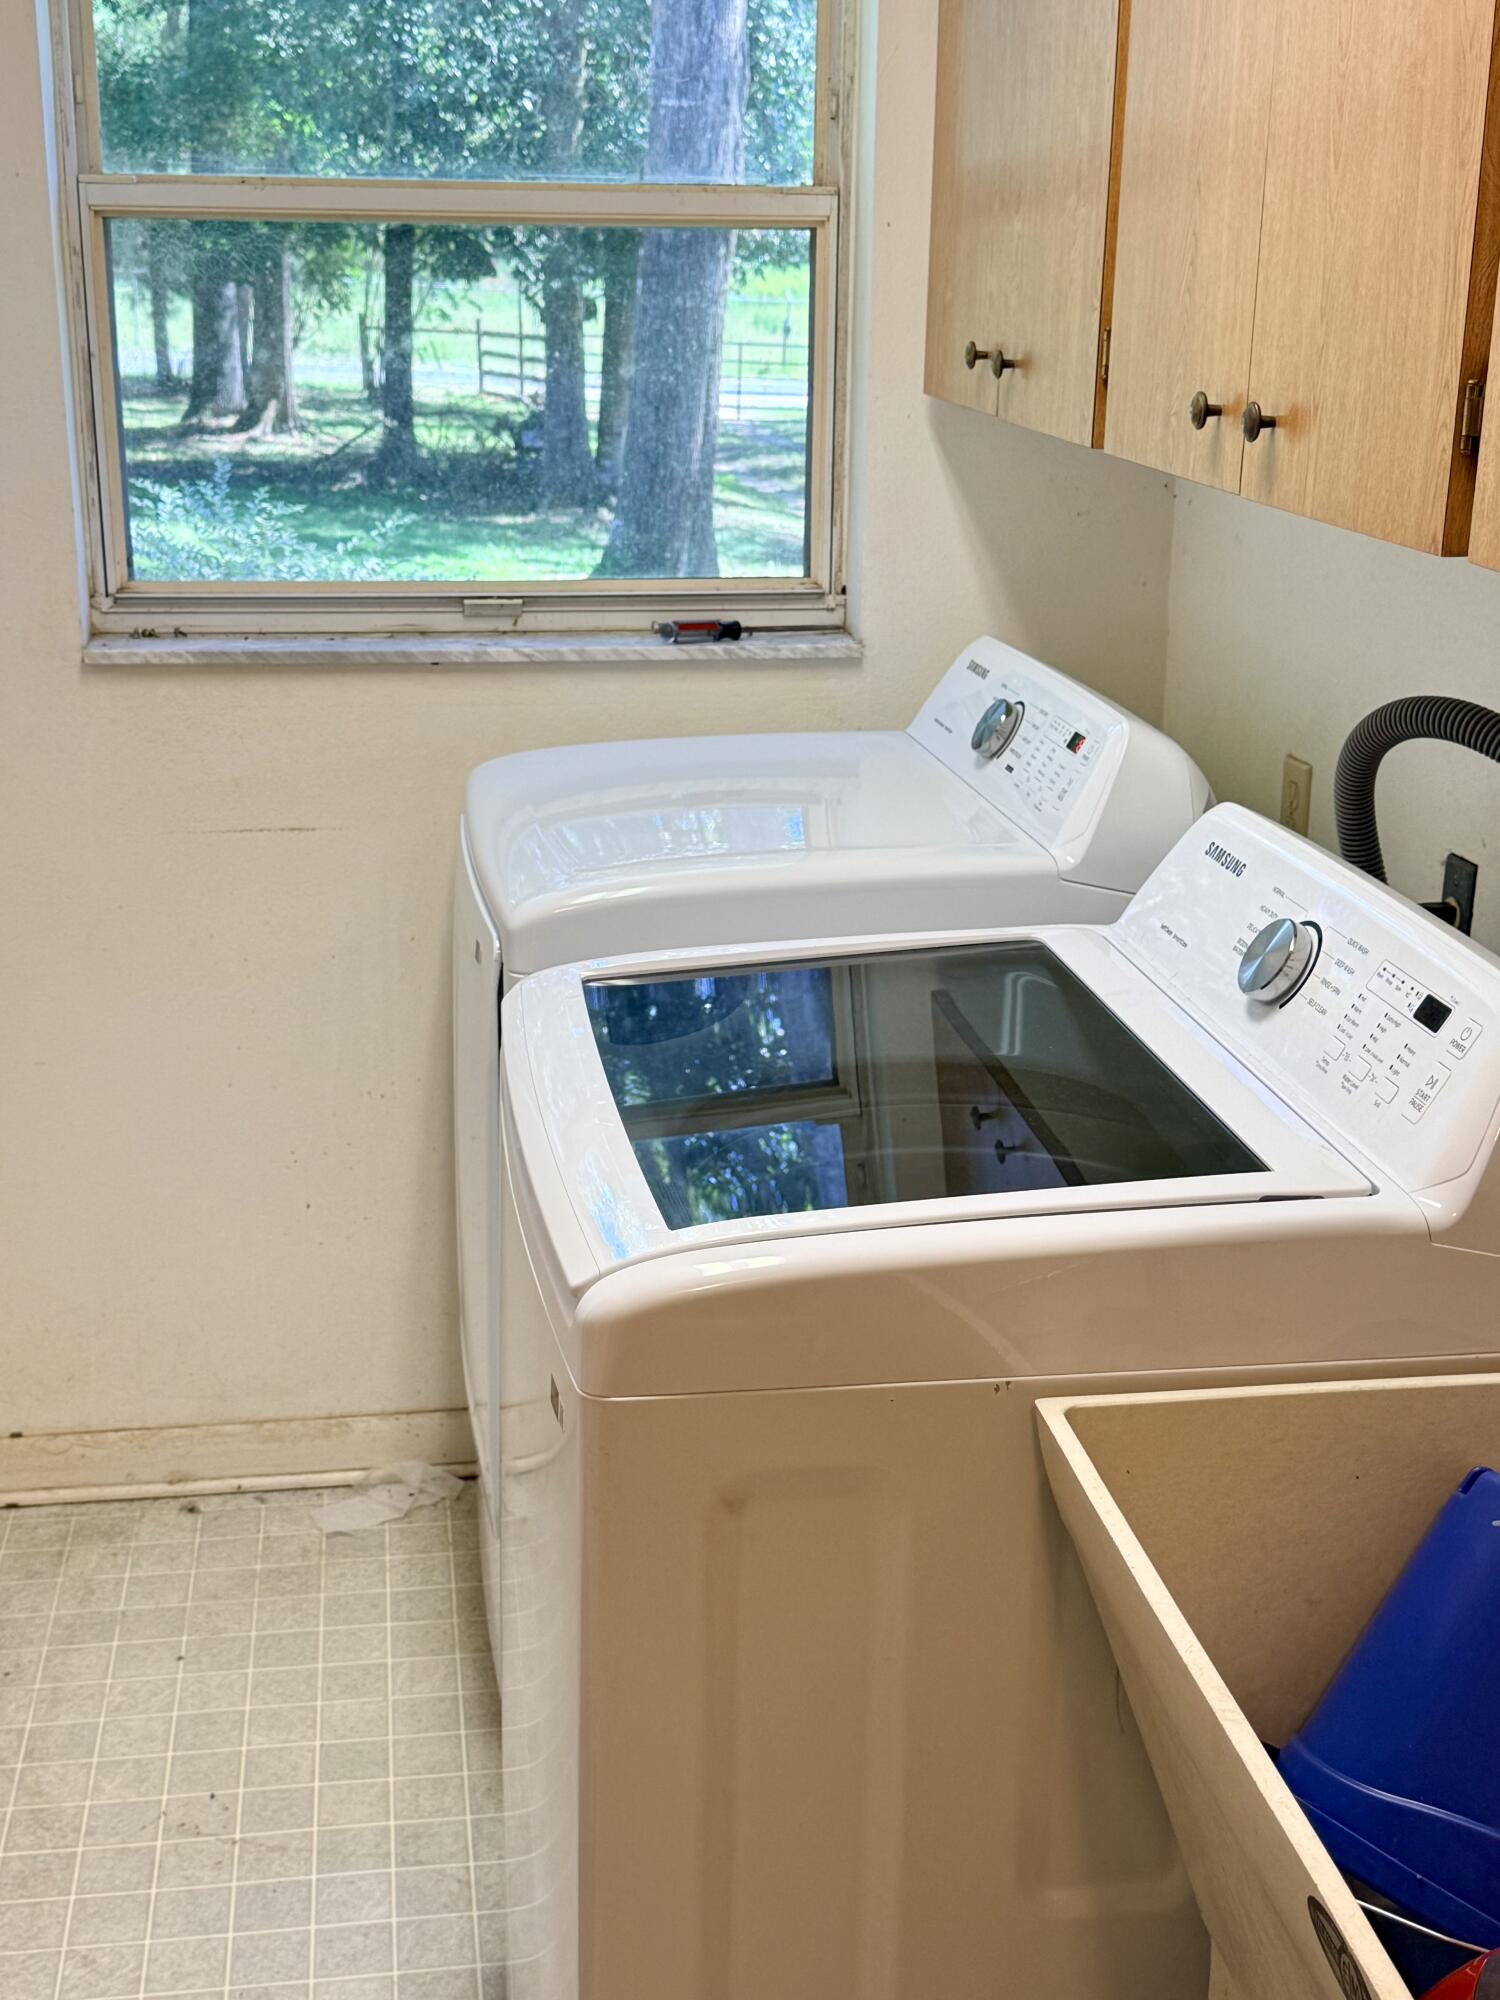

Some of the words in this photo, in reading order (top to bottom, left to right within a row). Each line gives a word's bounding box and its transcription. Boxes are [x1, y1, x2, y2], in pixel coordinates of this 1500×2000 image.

[1204, 841, 1247, 877] SAMSUNG
[1358, 943, 1369, 955] WASH
[1344, 965, 1355, 975] WASH
[1449, 1038, 1466, 1053] POWER
[1415, 1088, 1431, 1103] START
[1408, 1097, 1424, 1113] PAUSE
